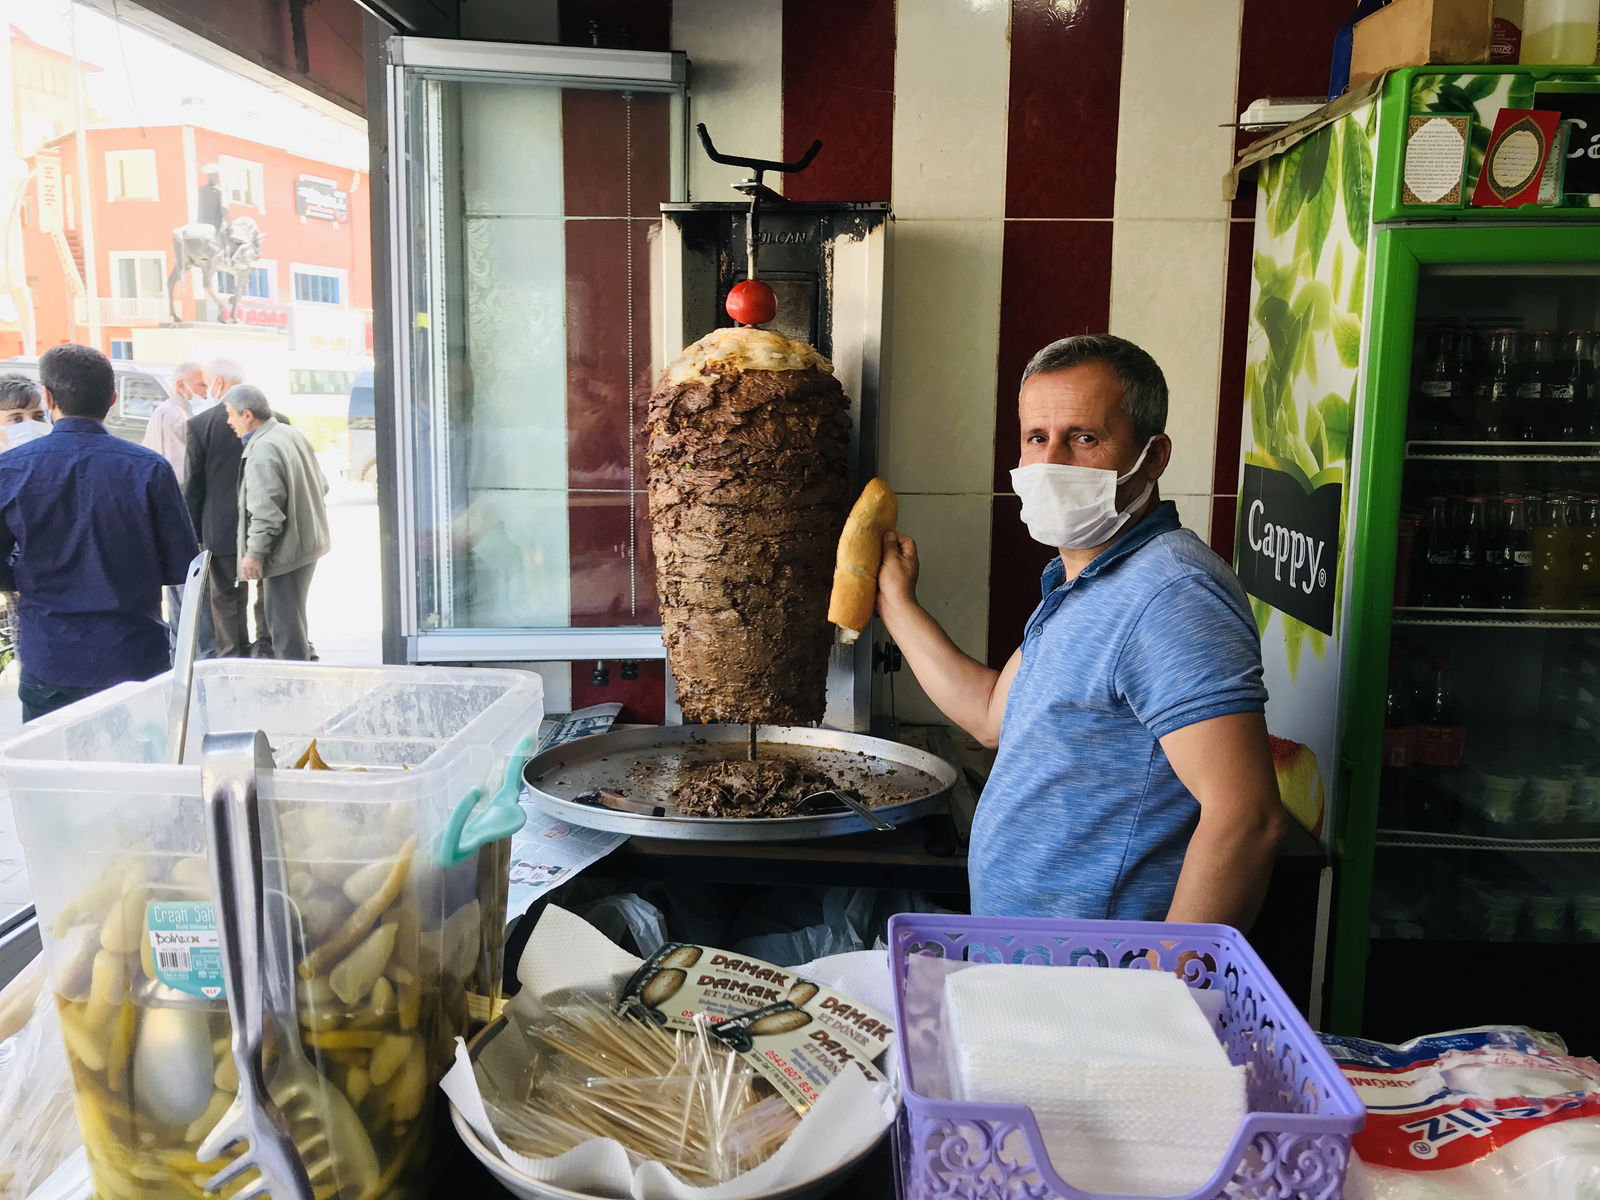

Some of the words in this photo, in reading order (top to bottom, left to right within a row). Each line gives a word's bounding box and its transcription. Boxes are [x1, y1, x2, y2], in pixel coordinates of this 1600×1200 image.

[757, 230, 806, 245] ÜLCAN
[710, 954, 790, 988] DAMAK
[696, 974, 781, 1004] DAMAK
[703, 988, 721, 999] ET
[818, 1012, 835, 1025] ET
[819, 996, 894, 1042] DAMAK
[802, 1042, 821, 1054] ET
[784, 1067, 802, 1081] 607
[808, 1092, 819, 1102] 5
[1346, 1076, 1416, 1089] ÜRÜM
